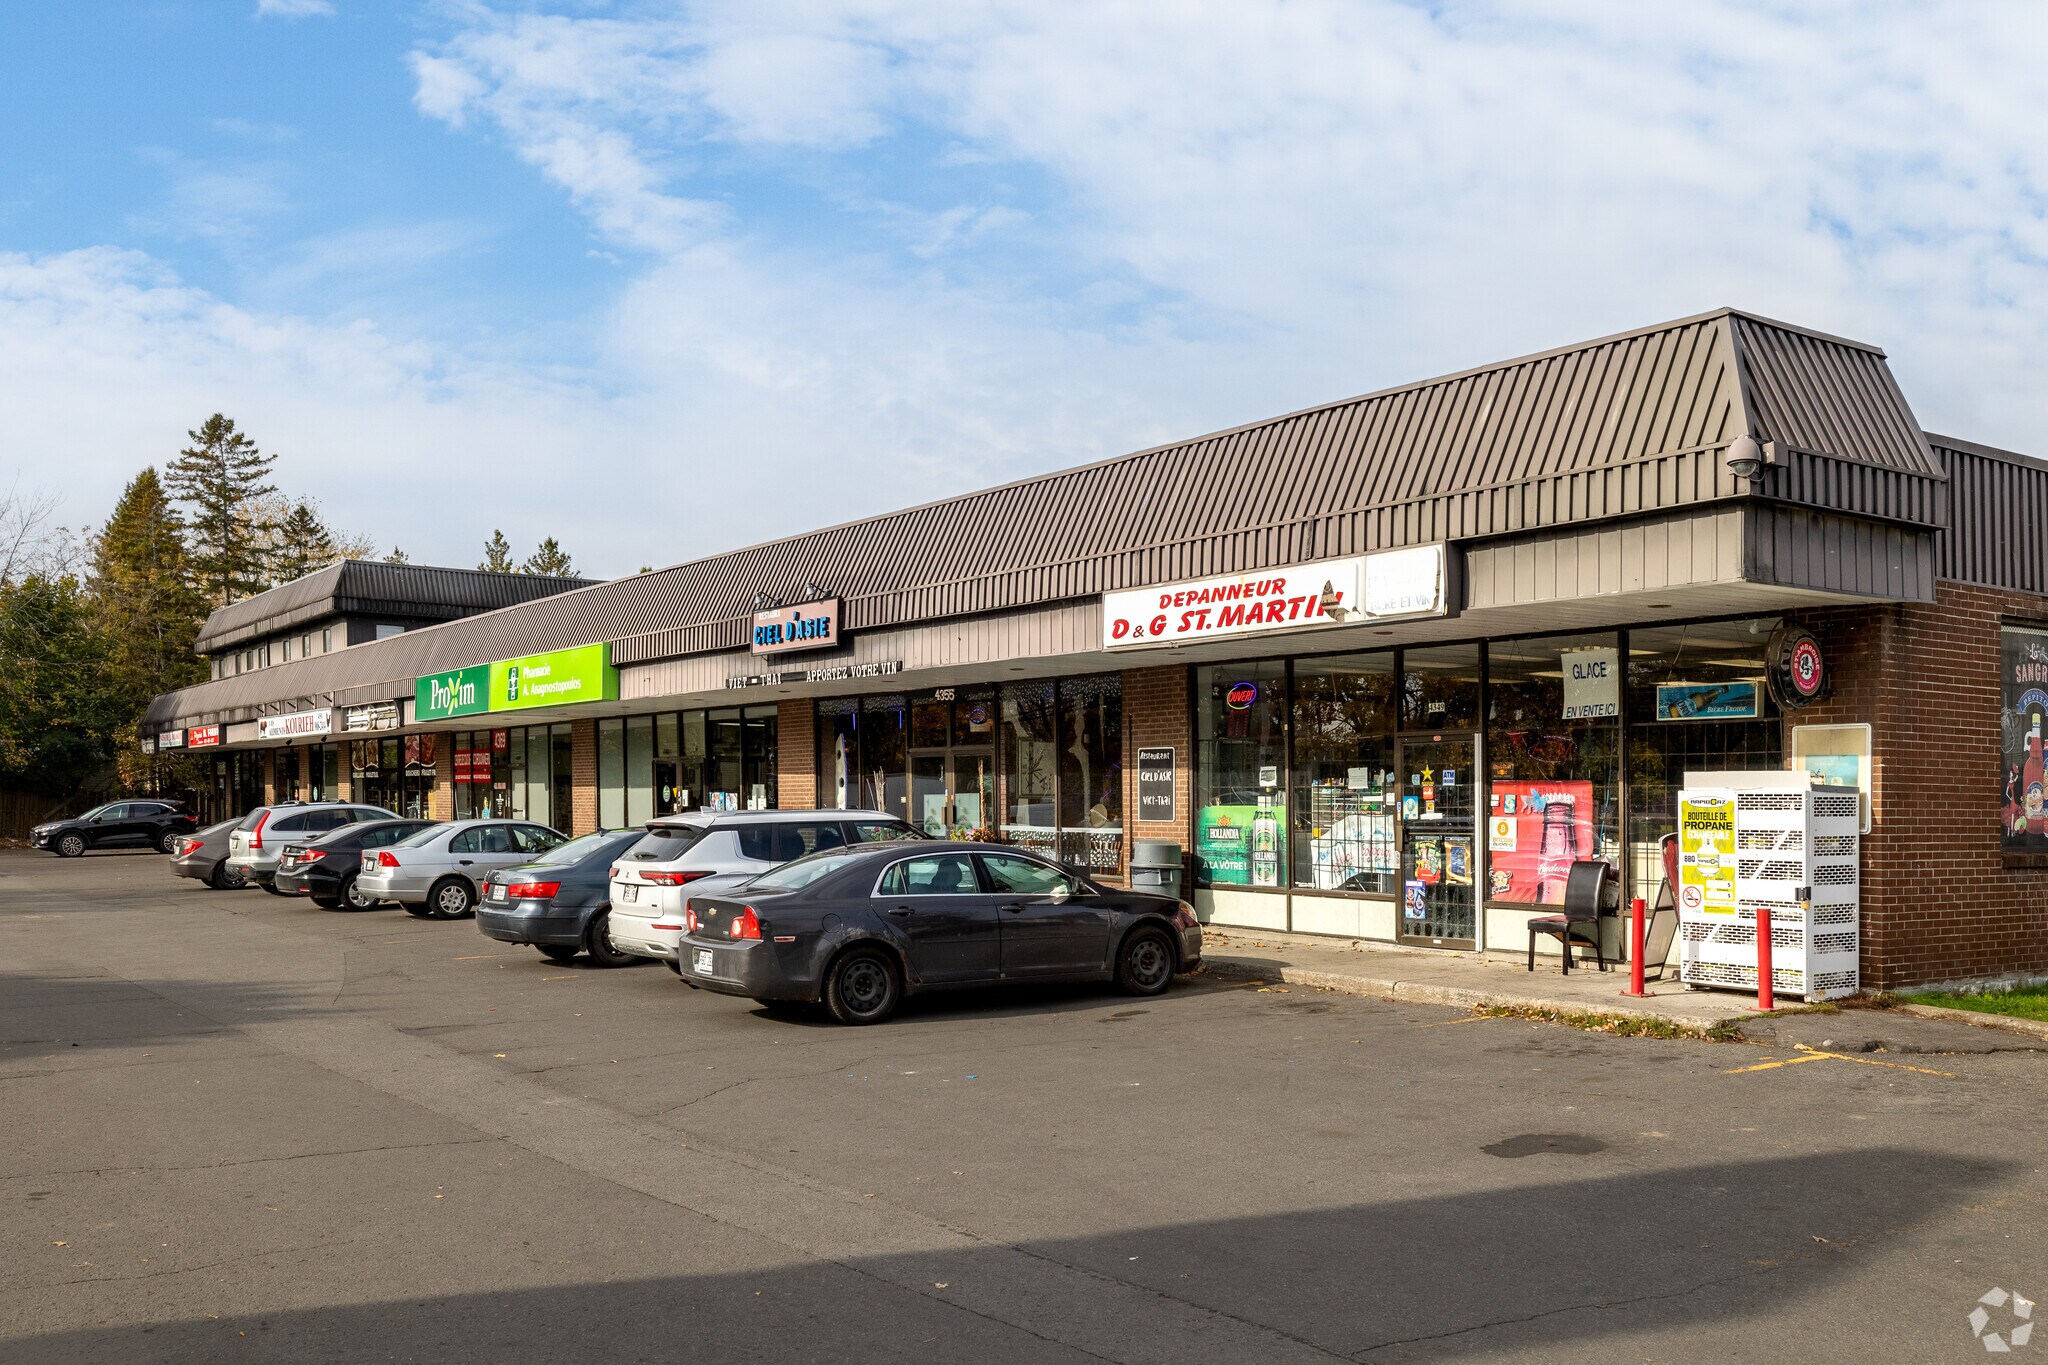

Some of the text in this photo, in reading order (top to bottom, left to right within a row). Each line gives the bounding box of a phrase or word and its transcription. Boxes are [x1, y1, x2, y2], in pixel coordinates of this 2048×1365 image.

[1159, 578, 1286, 609] DEPANNEUR
[754, 624, 782, 645] CIEL
[1112, 619, 1130, 639] D
[1133, 625, 1145, 638] &
[1149, 615, 1167, 636] G
[523, 662, 551, 679] Pharmacie
[728, 677, 748, 690] VIET
[760, 673, 782, 686] THAI
[806, 666, 848, 683] APPORTEZ
[850, 664, 879, 679] VOTRE
[881, 661, 898, 676] VIN
[1572, 661, 1607, 679] GLACE
[530, 676, 582, 697] Anagnostopoulos
[935, 688, 955, 700] 4355
[1228, 690, 1255, 702] OUVERT
[1428, 703, 1446, 712] 4349
[1566, 703, 1616, 718] EN VENTE ICI
[1688, 812, 1727, 821] BOUTEILLE DE
[1684, 821, 1733, 830] PROPANE
[1209, 828, 1240, 839] HOLLANDIA
[1209, 861, 1219, 870] LA
